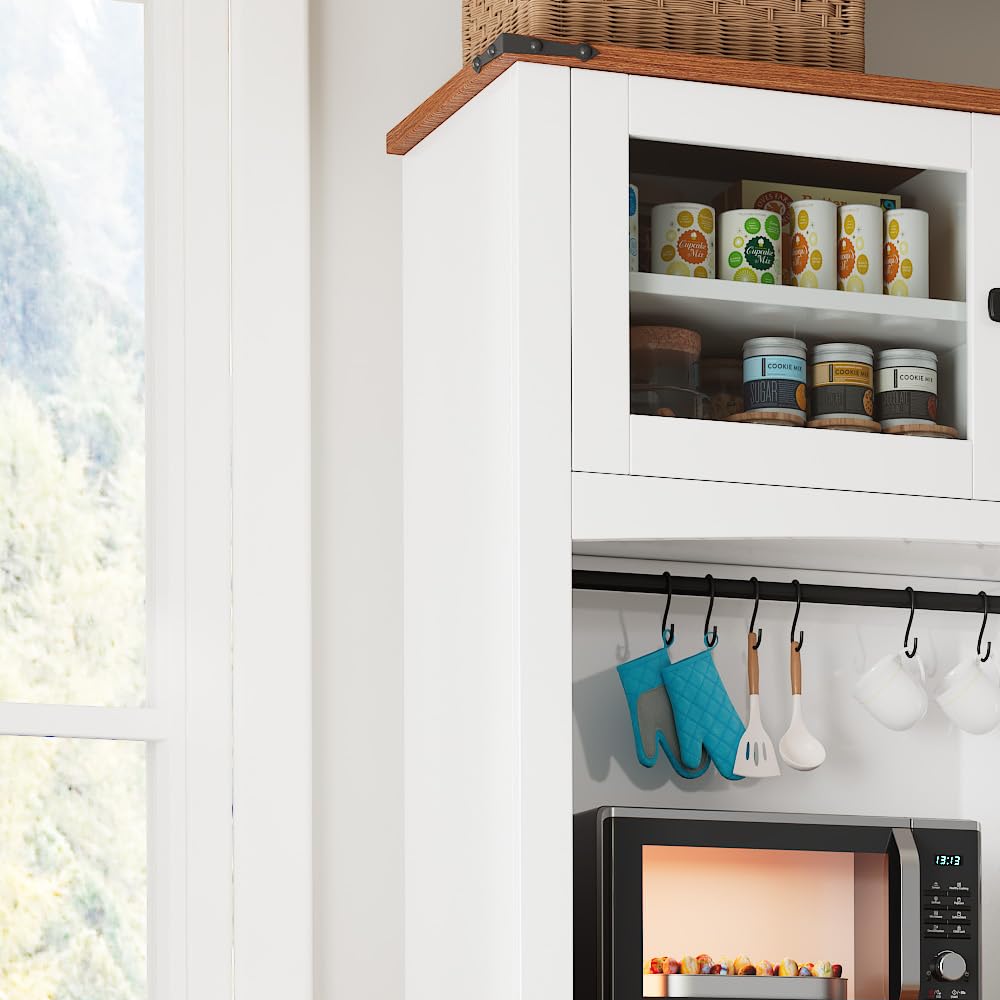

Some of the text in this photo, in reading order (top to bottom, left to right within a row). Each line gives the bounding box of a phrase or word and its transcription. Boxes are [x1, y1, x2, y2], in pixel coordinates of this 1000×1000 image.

[678, 240, 706, 250] Cupcake
[689, 249, 704, 258] Mix
[746, 247, 774, 256] Cupcake
[755, 255, 771, 265] Mix
[767, 362, 793, 371] COOKIE
[834, 368, 870, 378] COOKIE MIX
[899, 373, 924, 382] COOKIE
[750, 381, 778, 404] SUGAR
[935, 855, 961, 866] 13:13
